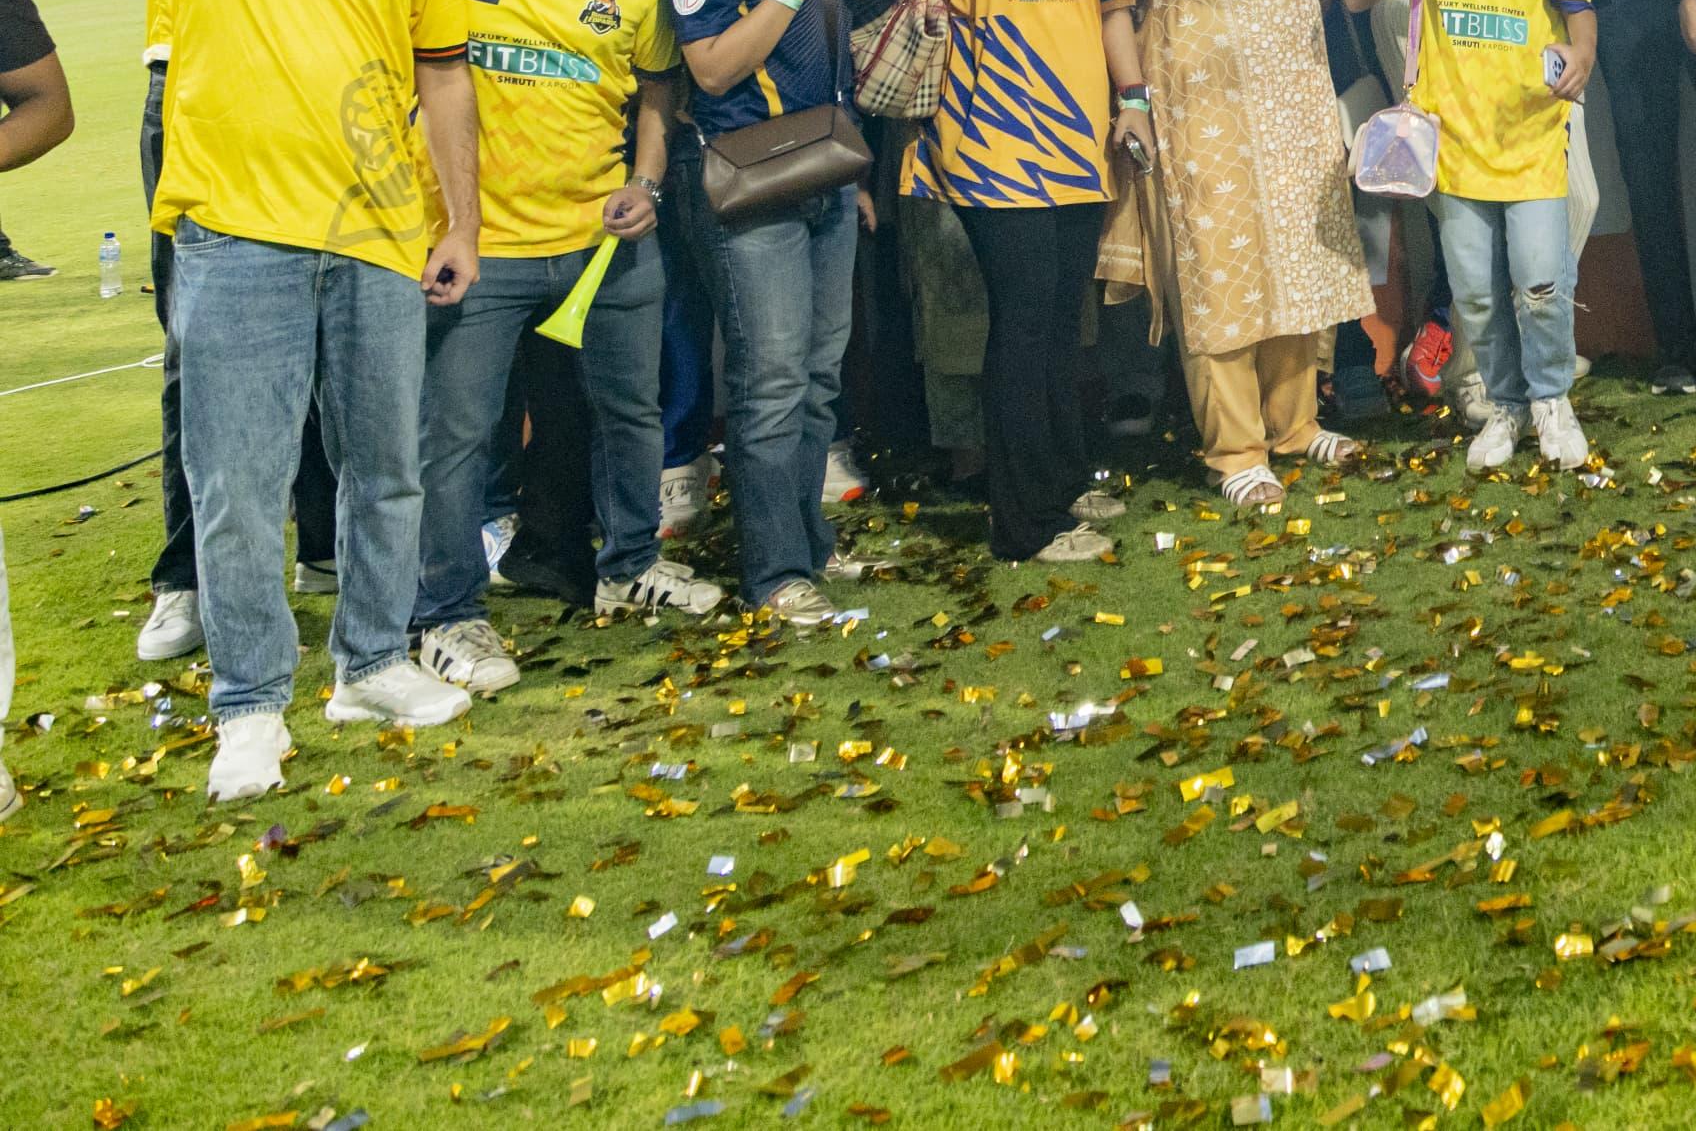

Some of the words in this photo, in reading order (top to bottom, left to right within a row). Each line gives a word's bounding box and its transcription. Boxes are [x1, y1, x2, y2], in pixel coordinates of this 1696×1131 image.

[1462, 2, 1499, 12] WELLNESS
[467, 30, 508, 43] LUXURY
[467, 39, 598, 82] FITBLISS
[496, 75, 537, 87] SHRUTI
